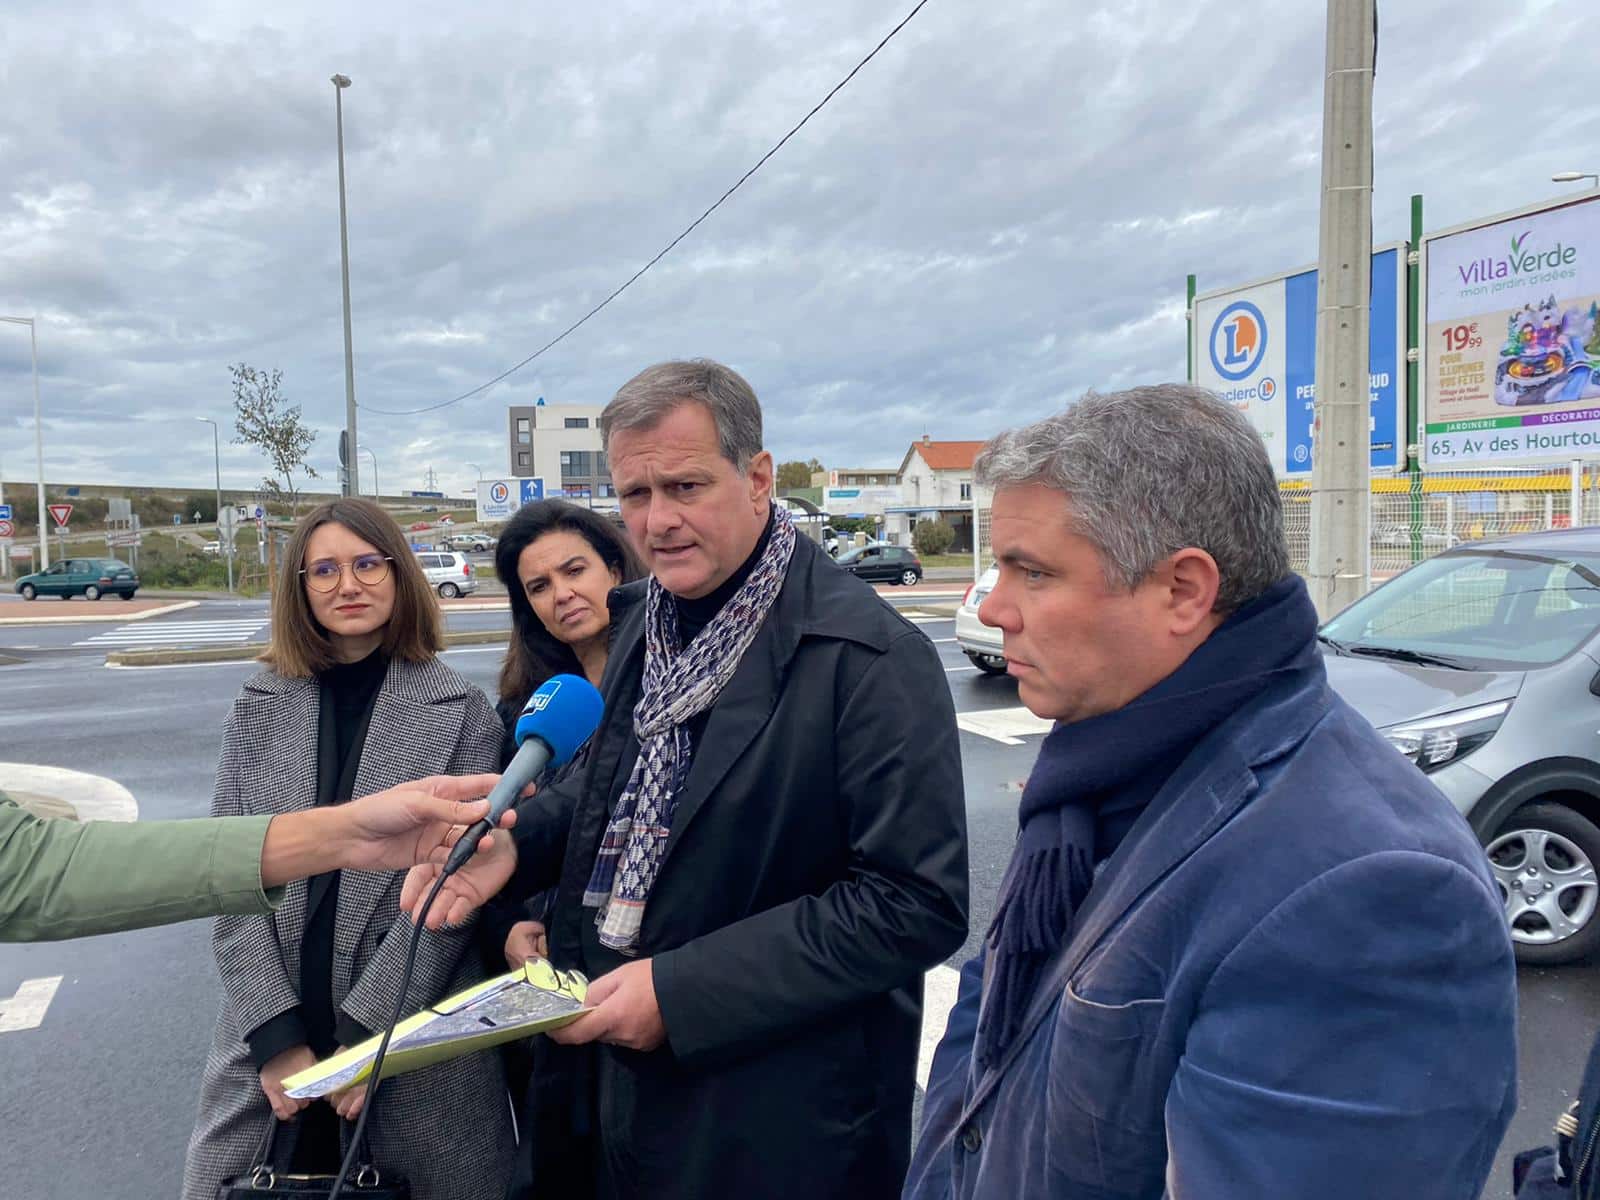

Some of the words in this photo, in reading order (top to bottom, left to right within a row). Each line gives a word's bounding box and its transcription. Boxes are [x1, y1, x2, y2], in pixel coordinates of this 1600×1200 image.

[1459, 243, 1577, 284] VillaVerde
[1446, 419, 1497, 434] JARDINERIE
[1431, 439, 1457, 457] 65,
[1463, 437, 1484, 454] Av
[1489, 434, 1519, 452] des
